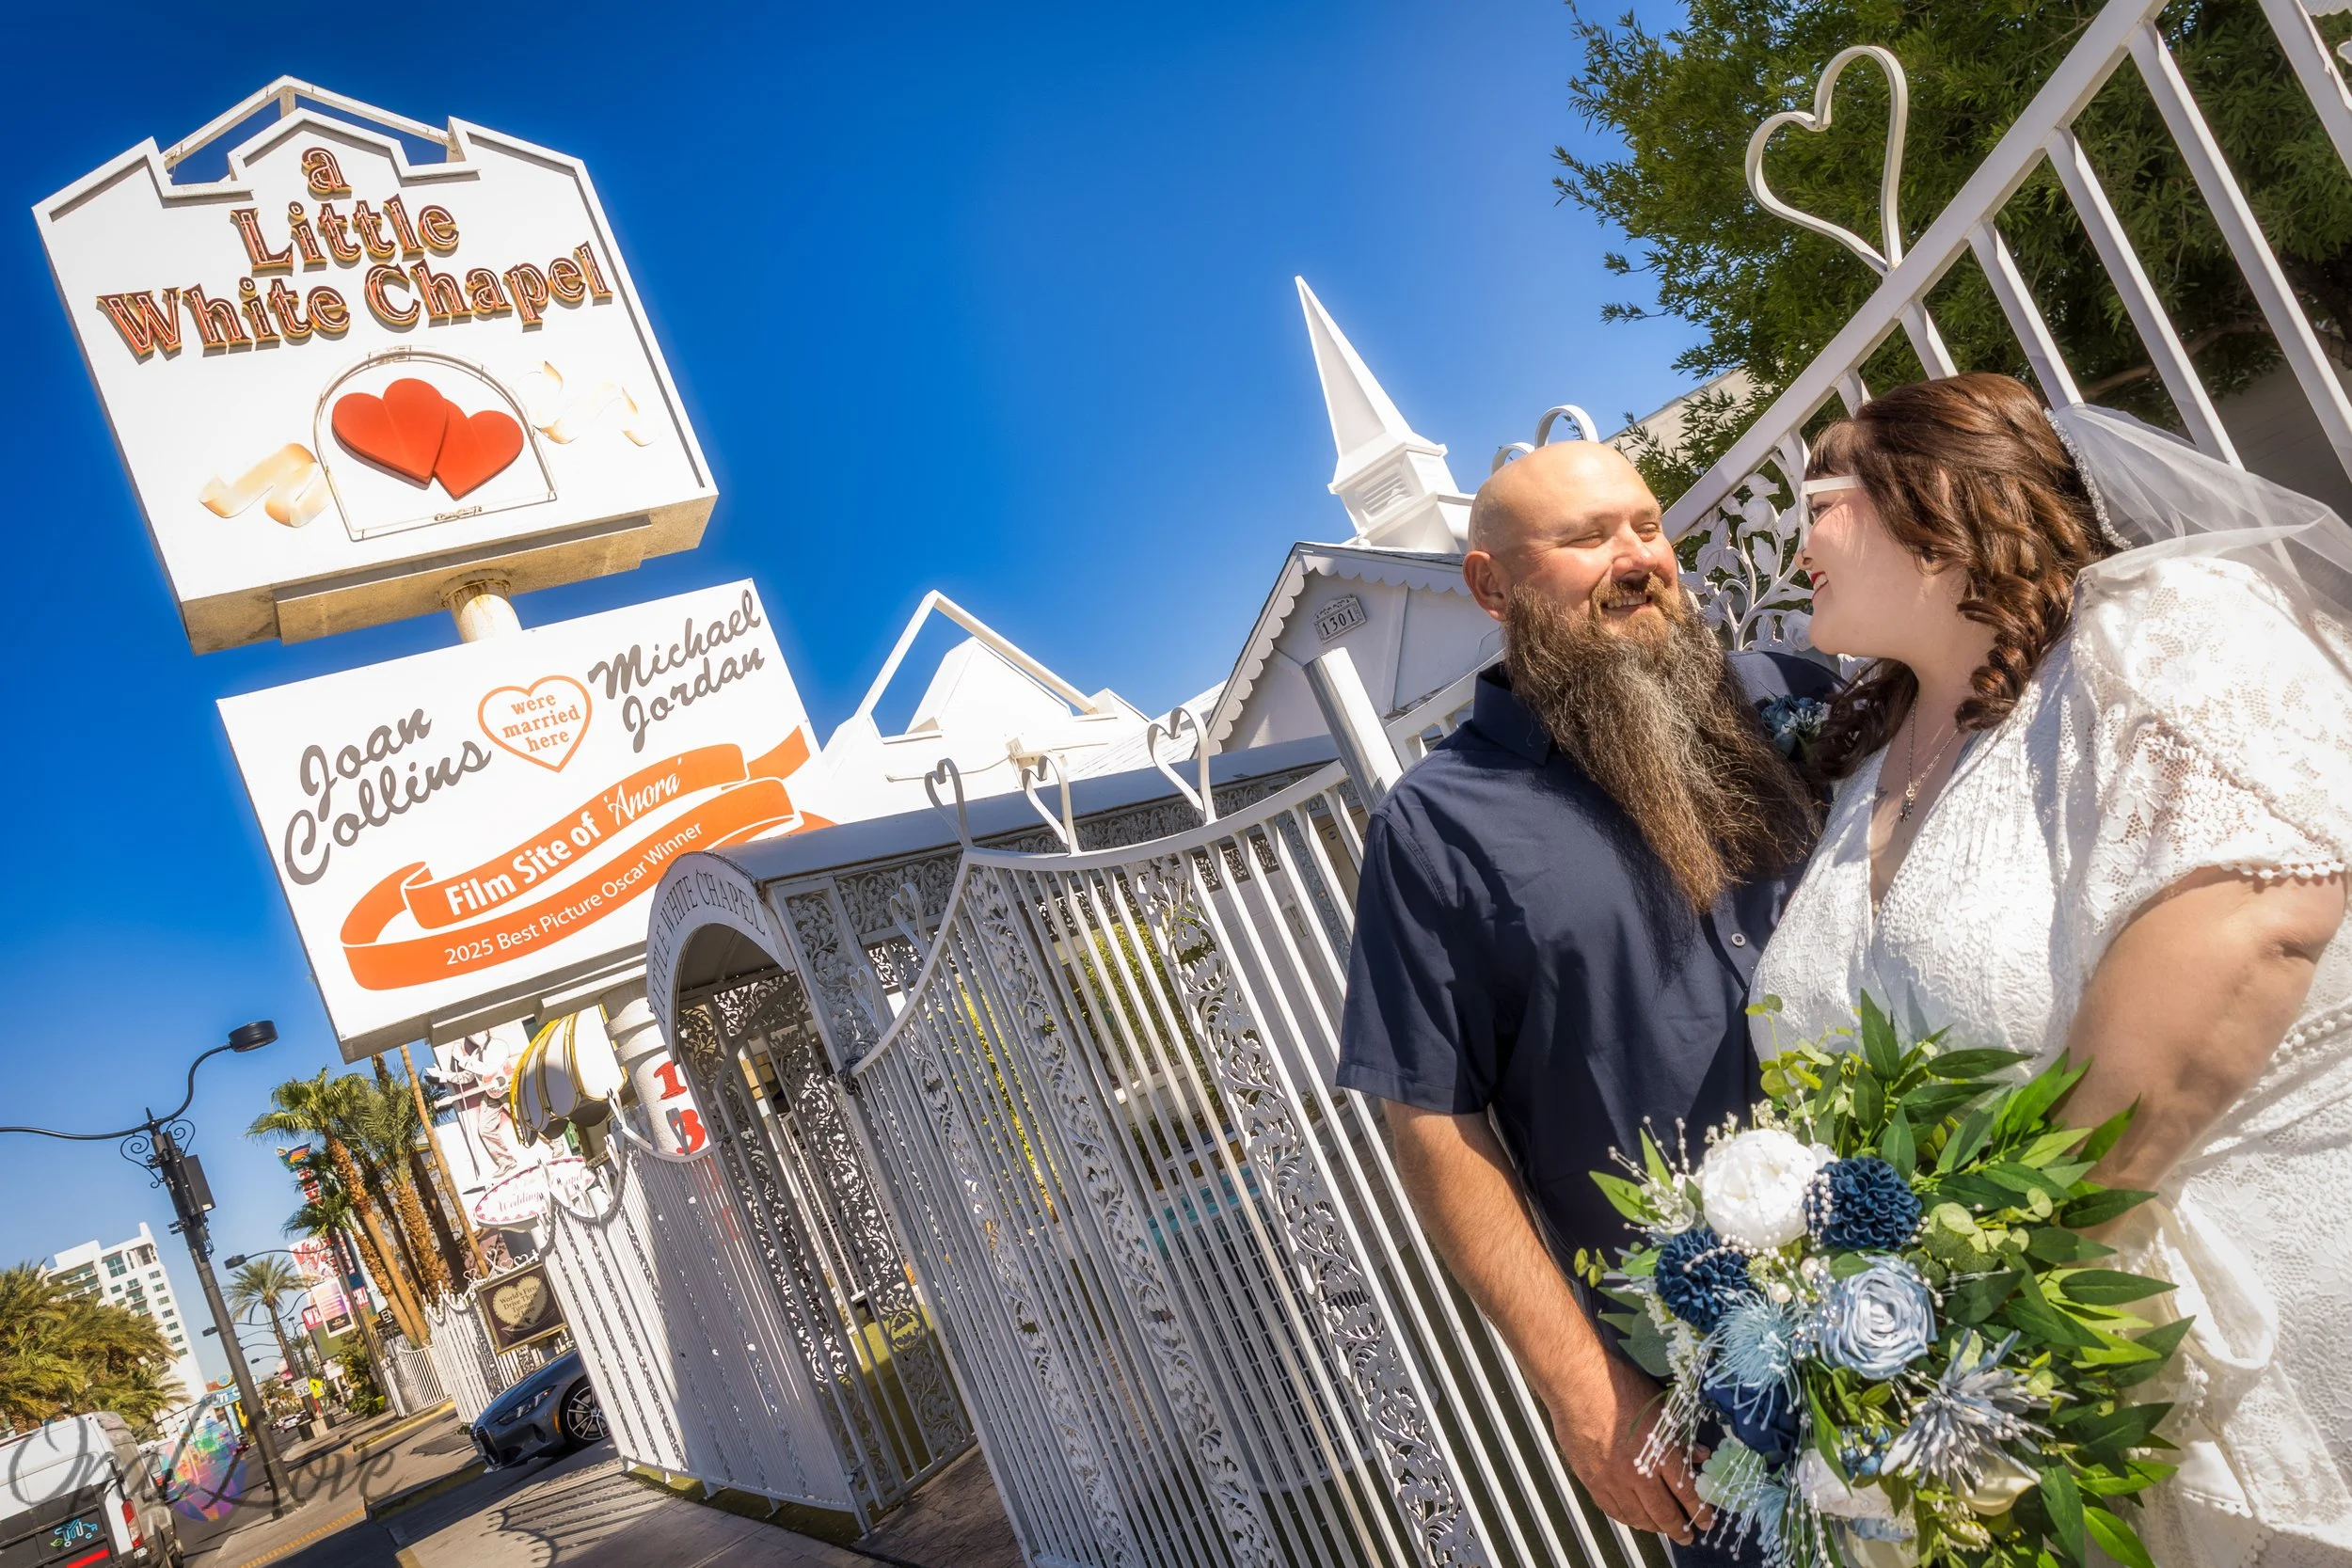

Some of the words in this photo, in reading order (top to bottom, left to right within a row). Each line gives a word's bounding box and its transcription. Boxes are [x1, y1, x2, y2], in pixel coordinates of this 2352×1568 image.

[301, 148, 351, 198] a
[231, 197, 458, 274] Little
[98, 277, 350, 357] White
[364, 242, 612, 328] Chapel
[588, 590, 760, 700] Michael
[1322, 610, 1356, 636] 1301
[502, 705, 580, 738] married
[510, 691, 557, 716] were
[623, 648, 765, 753] Jordan
[300, 707, 432, 822] Joan
[526, 731, 569, 753] here
[284, 741, 491, 885] Collins
[444, 872, 517, 916] Film
[512, 839, 572, 884] Site
[570, 811, 601, 847] of
[444, 939, 494, 966] 2025
[496, 915, 540, 951] Best
[538, 893, 603, 933] Picture
[601, 862, 648, 898] Oscar
[643, 821, 703, 866] Winner
[660, 875, 698, 939] WHITE
[695, 869, 766, 937] CHAPEL
[296, 1386, 310, 1397] 30
